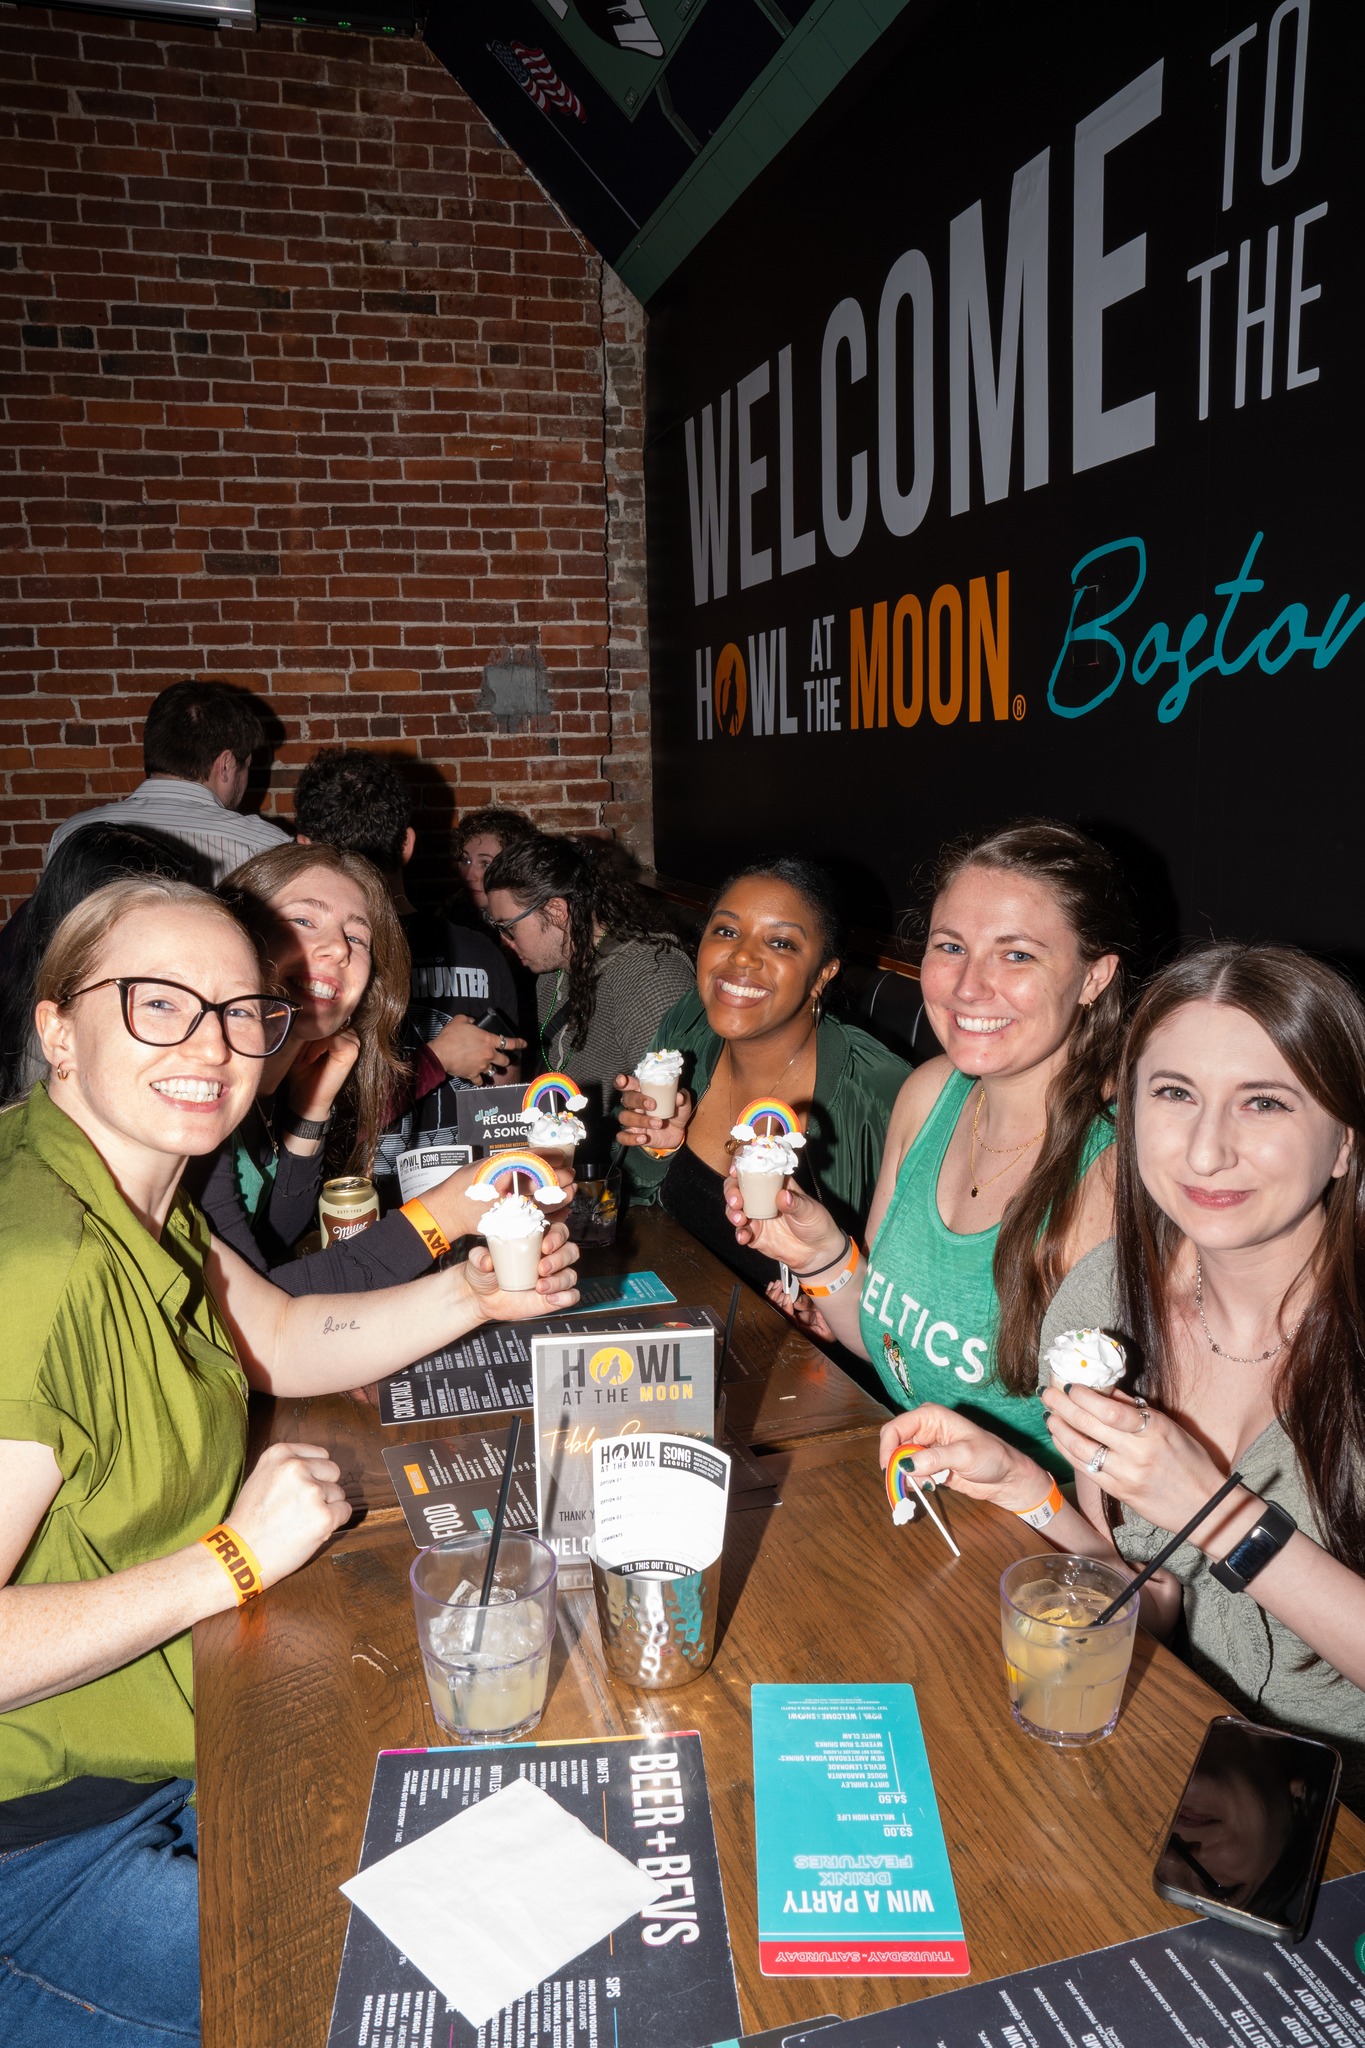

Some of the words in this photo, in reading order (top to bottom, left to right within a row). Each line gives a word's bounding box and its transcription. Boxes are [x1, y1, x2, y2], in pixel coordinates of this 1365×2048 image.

[685, 56, 1164, 607] WELCOME
[1210, 0, 1310, 212] TO
[1187, 202, 1328, 421] THE
[1047, 530, 1365, 724] Boston
[803, 675, 842, 732] THE
[850, 570, 1011, 731] MOON
[810, 614, 834, 672] AT
[412, 966, 489, 999] HUNTER
[483, 1113, 522, 1125] REQUE
[483, 1129, 492, 1139] A
[422, 1153, 439, 1163] SONG
[333, 1221, 368, 1240] Miller
[860, 1263, 988, 1384] ELTICS
[390, 1380, 416, 1419] COCKTAILS
[563, 1390, 583, 1406] AT
[594, 1388, 629, 1403] THE
[640, 1384, 693, 1402] MOON
[542, 1425, 598, 1457] Tabl
[663, 1446, 691, 1463] SONG
[663, 1459, 691, 1469] REQUEST
[600, 1465, 609, 1473] AT
[613, 1462, 627, 1470] THE
[632, 1460, 655, 1468] MOON
[423, 1503, 468, 1540] FOOD
[559, 1510, 587, 1522] THANK
[546, 1537, 591, 1557] WELC
[206, 1530, 259, 1601] FRIDA
[621, 1563, 633, 1573] FILL
[635, 1562, 650, 1571] THIS
[651, 1561, 664, 1570] OUT
[665, 1562, 674, 1571] TO
[674, 1563, 686, 1575] WIN
[442, 1768, 450, 1786] CORONA
[453, 1767, 461, 1786] CORONA
[488, 1765, 502, 1793] BOTTLES
[596, 1757, 609, 1784] DRAFTS
[441, 1786, 449, 1799] LIGHT
[628, 1752, 685, 1828] BEER
[878, 1793, 907, 1804] $4.50
[870, 1813, 895, 1821] MILLER
[884, 1826, 913, 1837] $3.00
[794, 1854, 912, 1869] FEATURES
[819, 1871, 891, 1886] DRINK
[784, 1890, 858, 1913] PARTY
[864, 1890, 880, 1913] A
[887, 1890, 934, 1912] WIN
[776, 1951, 860, 1962] SATURDAY
[866, 1951, 954, 1962] THURSDAY
[543, 1982, 551, 1994] ASK
[578, 1980, 586, 1992] ASK
[588, 1979, 596, 1995] HIGH
[606, 1977, 621, 1998] SIPS
[1142, 1978, 1158, 1992] BLUE
[1263, 1971, 1279, 1986] SOUR
[389, 1993, 398, 2006] RED
[414, 1991, 424, 2010] PINOT
[543, 1994, 552, 2006] FOR
[566, 1980, 574, 2000] TRIPLE
[578, 1992, 587, 2004] FOR
[1226, 1982, 1249, 2005] BANANA
[1276, 1986, 1295, 2005] LEMON
[374, 1994, 385, 2027] PROSECCO
[400, 1992, 411, 2018] MALBEC
[426, 1990, 437, 2027] SAUVIGNON
[530, 1995, 539, 2013] LONG
[553, 2001, 561, 2025] VODKA
[566, 2000, 574, 2018] EIGHT
[588, 1995, 597, 2015] NOON
[1294, 1989, 1332, 2023] CANDY
[387, 2006, 397, 2028] BLEND
[412, 2010, 422, 2034] GRIGIO
[517, 2003, 526, 2030] TEQUILA
[530, 2013, 538, 2034] DRINK
[543, 2006, 552, 2033] FLAVORS
[578, 2004, 587, 2030] FLAVORS
[1212, 2009, 1230, 2027] PEACH
[1245, 2004, 1266, 2026] BUTTER
[358, 2012, 371, 2046] PROSECCO
[504, 2015, 513, 2042] ORANGE
[589, 2015, 597, 2038] VODKA
[1281, 2016, 1313, 2044] DROP
